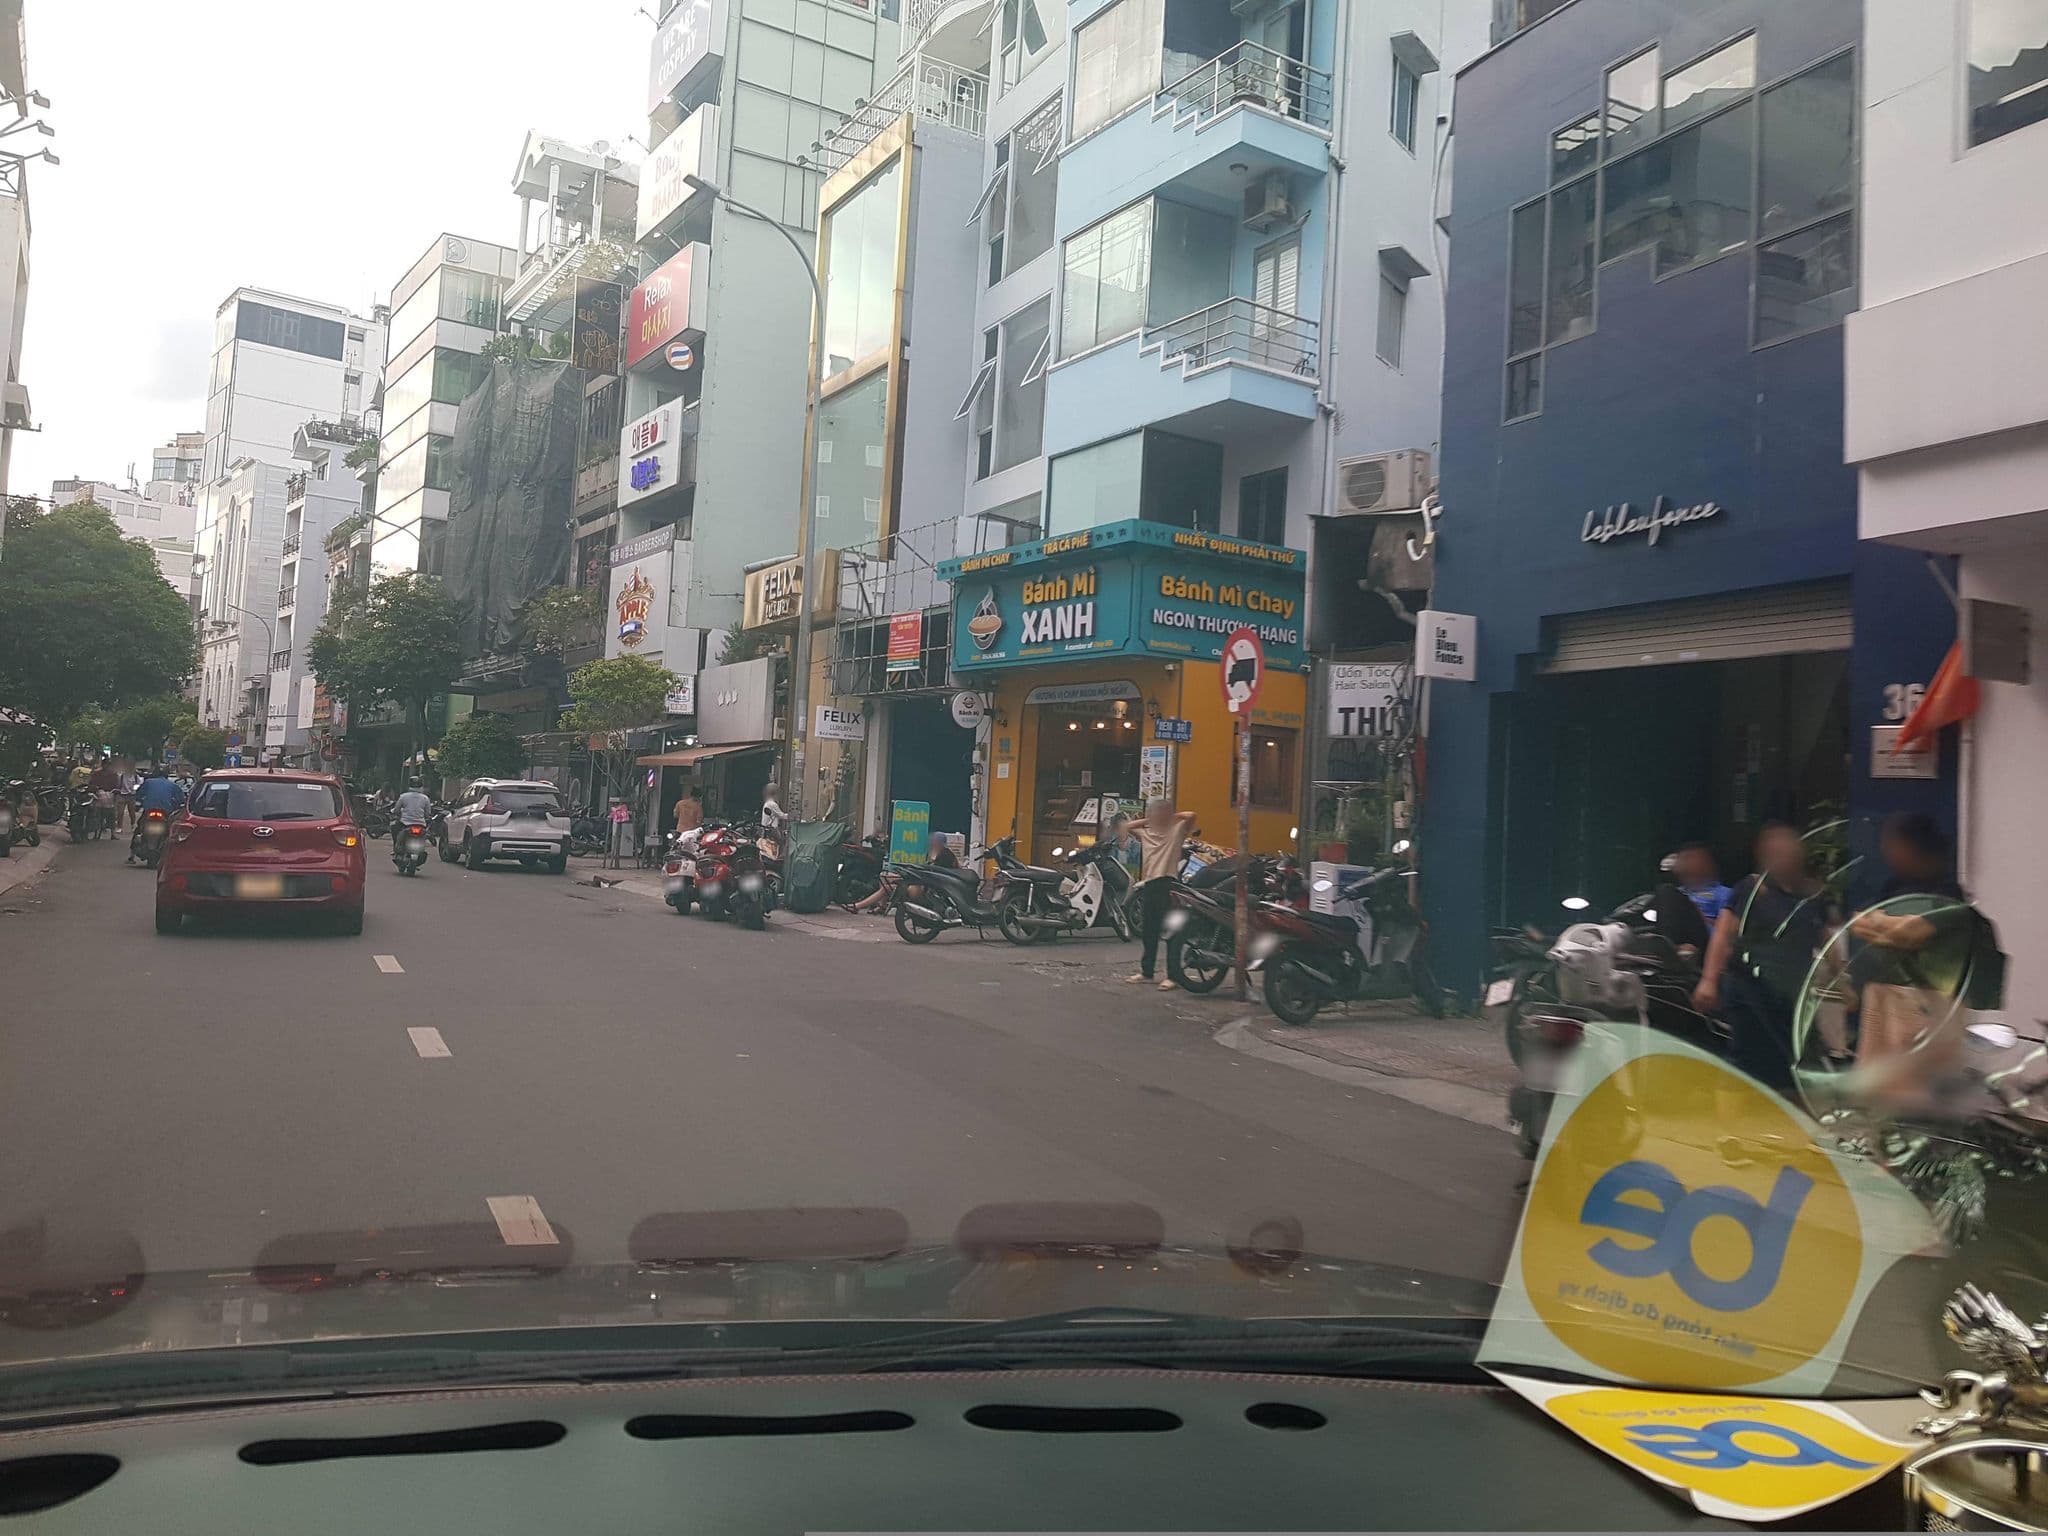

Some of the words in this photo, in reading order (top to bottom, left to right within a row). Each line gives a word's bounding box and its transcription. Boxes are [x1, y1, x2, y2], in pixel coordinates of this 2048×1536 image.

[658, 29, 697, 85] COSPLAY
[662, 28, 675, 57] WE
[644, 277, 672, 312] Relax
[641, 301, 672, 345] 마사지
[632, 420, 650, 450] 애플
[634, 531, 670, 557] BARBERSHOP
[1174, 530, 1207, 547] NHẤT
[1209, 539, 1239, 554] ĐỊNH
[1242, 544, 1269, 560] PHẢI
[991, 553, 1010, 567] CHAY
[764, 566, 797, 602] FELIX
[1023, 575, 1067, 604] Bánh
[1160, 575, 1214, 603] Bánh
[1219, 585, 1242, 607] Mì
[1246, 590, 1295, 619] Chay
[620, 598, 648, 626] APPLE
[766, 597, 790, 618] LUXURY
[1021, 602, 1093, 644] XANH
[1152, 608, 1194, 629] NGON
[1260, 625, 1297, 645] HẠNG
[1335, 680, 1357, 690] Hair
[1360, 680, 1390, 690] Salon
[824, 710, 861, 725] FELIX
[895, 808, 928, 822] Bánh
[892, 849, 926, 864] Chay
